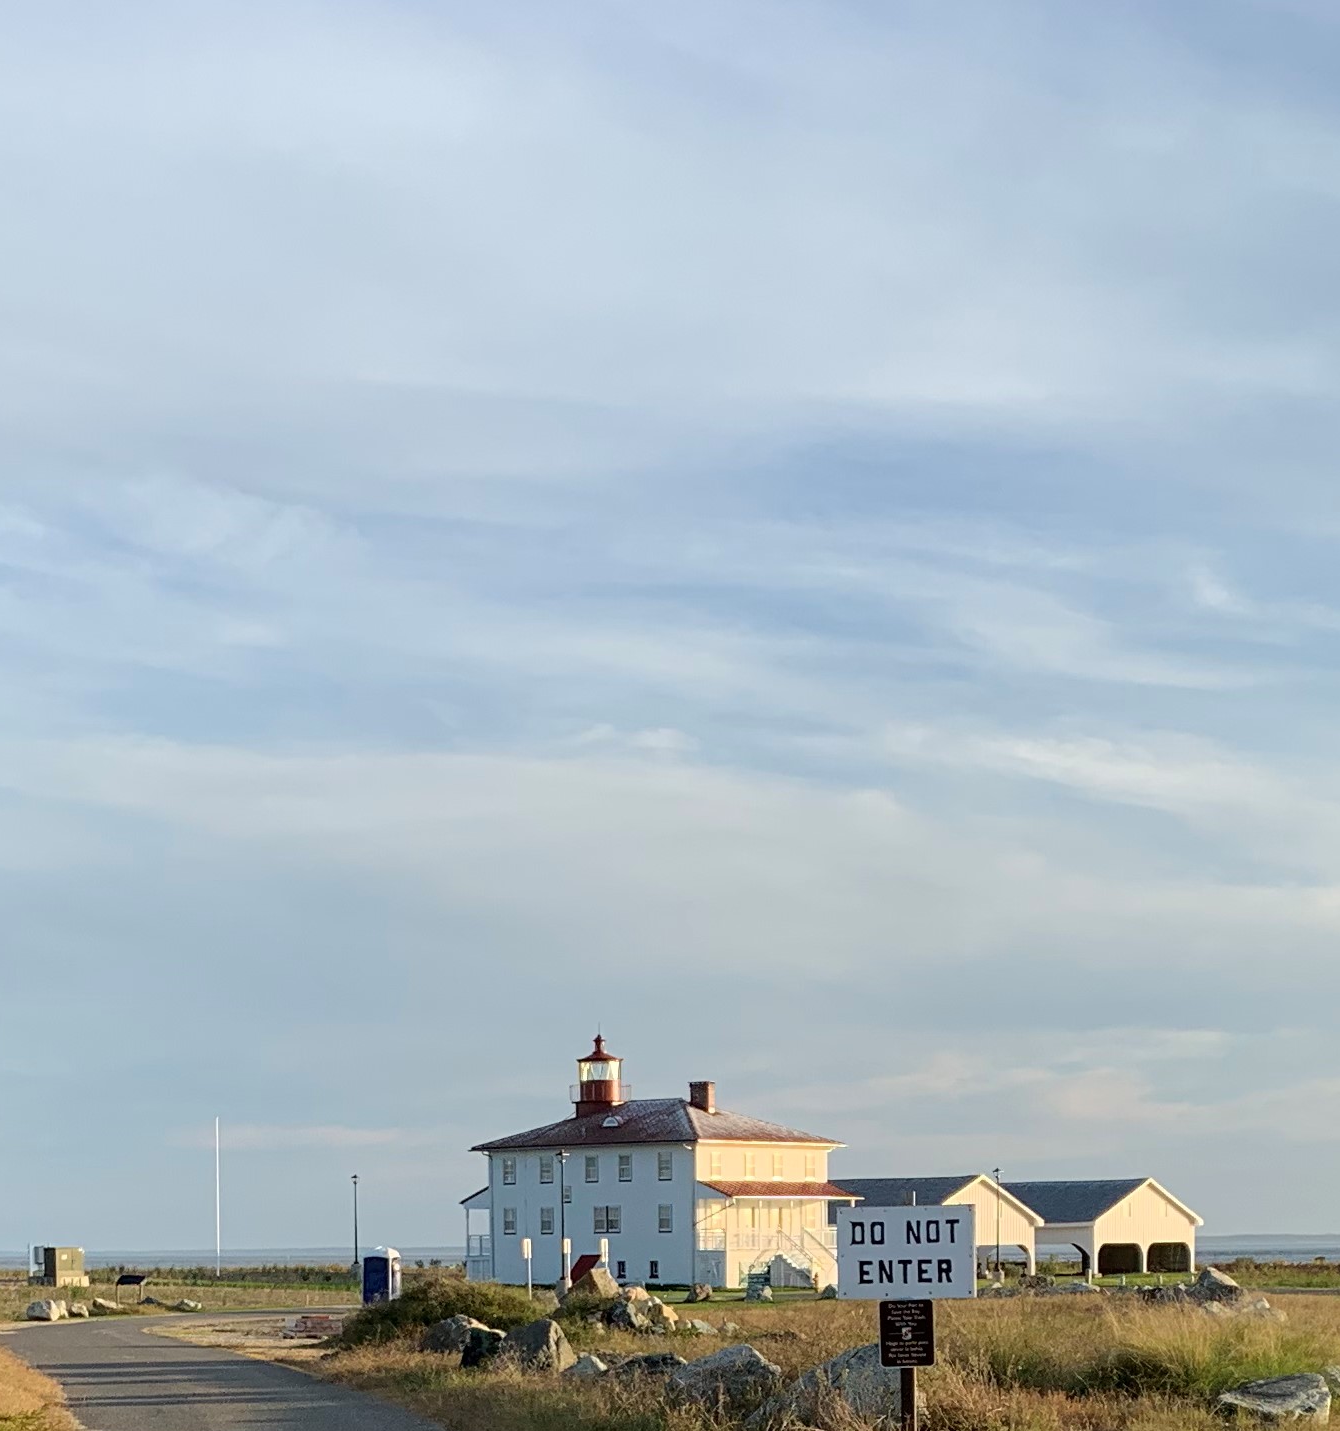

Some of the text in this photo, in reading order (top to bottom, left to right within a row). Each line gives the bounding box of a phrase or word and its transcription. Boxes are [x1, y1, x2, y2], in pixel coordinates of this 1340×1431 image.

[850, 1219, 960, 1246] DO NOT
[858, 1259, 952, 1284] ENTER
